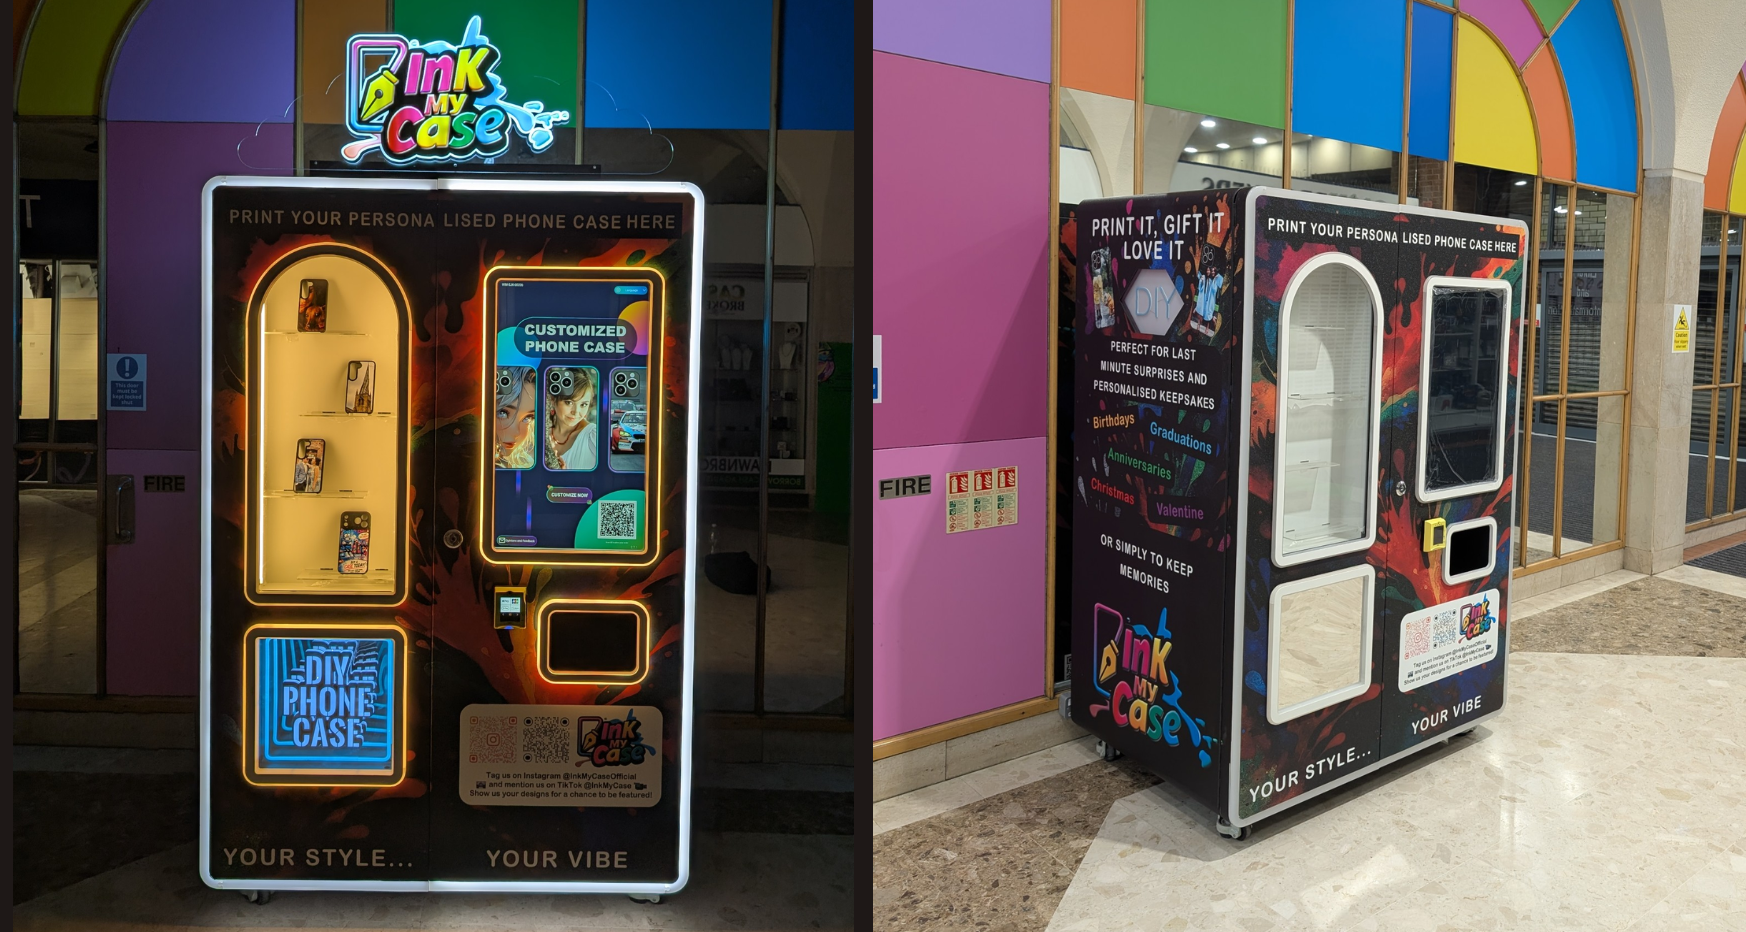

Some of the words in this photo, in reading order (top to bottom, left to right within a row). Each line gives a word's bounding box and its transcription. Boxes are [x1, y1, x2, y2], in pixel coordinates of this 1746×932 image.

[386, 105, 506, 154] Case
[229, 209, 285, 224] PRINT
[291, 210, 342, 226] YOUR
[349, 212, 435, 228] PERSONA
[443, 213, 496, 228] LISED
[503, 214, 566, 229] PHONE
[572, 214, 622, 230] CASE
[626, 214, 676, 230] HERE
[1092, 216, 1134, 236] PRINT
[1140, 216, 1157, 238] IT,
[1164, 214, 1202, 234] GIFT
[1209, 212, 1224, 234] IT
[1268, 218, 1306, 234] PRINT
[1310, 222, 1343, 238] YOUR
[1346, 226, 1398, 243] PERSONA
[1402, 233, 1431, 246] LISED
[1434, 236, 1467, 249] PHONE
[1469, 238, 1493, 252] CASE
[1494, 240, 1517, 253] HERE
[1124, 240, 1162, 260] LOVE
[1170, 240, 1184, 260] IT
[1135, 286, 1176, 319] DIY
[524, 324, 626, 337] CUSTOMIZED
[525, 340, 579, 352] PHONE
[584, 342, 625, 353] CASE
[1110, 340, 1148, 356] PERFECT
[1151, 345, 1169, 358] FOR
[1172, 347, 1196, 361] LAST
[1100, 360, 1132, 374] MINUTE
[1134, 364, 1184, 382] SURPRISES
[1188, 372, 1208, 385] AND
[1093, 380, 1157, 400] PERSONALISED
[1160, 389, 1215, 410] KEEPSAKES
[1093, 414, 1135, 429] Birthdays
[1150, 421, 1212, 455] Graduations
[1108, 447, 1172, 480] Anniversaries
[144, 476, 185, 491] FIRE
[880, 476, 931, 498] FIRE
[1090, 477, 1135, 505] Christmas
[1156, 502, 1204, 520] Valentine
[1100, 534, 1113, 548] OR
[1115, 539, 1147, 561] SIMPLY
[1150, 551, 1163, 567] TO
[1166, 557, 1194, 578] KEEP
[1120, 563, 1170, 594] MEMORIES
[1466, 618, 1491, 638] Case
[1423, 662, 1438, 672] mention
[1433, 651, 1452, 662] Instagram
[306, 655, 350, 685] DIY
[283, 686, 371, 717] PHONE
[1112, 680, 1181, 747] Case
[1411, 709, 1448, 735] YOUR
[1453, 696, 1482, 718] VIBE
[293, 717, 360, 748] CASE
[593, 744, 644, 765] Case
[486, 772, 500, 780] Tag
[523, 772, 561, 781] Instagram
[562, 772, 637, 781] @InkMyCaseOfficial
[1250, 770, 1299, 802] YOUR
[1305, 747, 1371, 780] STYLE...
[520, 790, 550, 799] designs
[584, 782, 632, 790] @InkMyCase
[223, 848, 295, 866] YOUR
[305, 848, 413, 868] STYLE...
[486, 850, 558, 868] YOUR
[568, 850, 628, 869] VIBE
